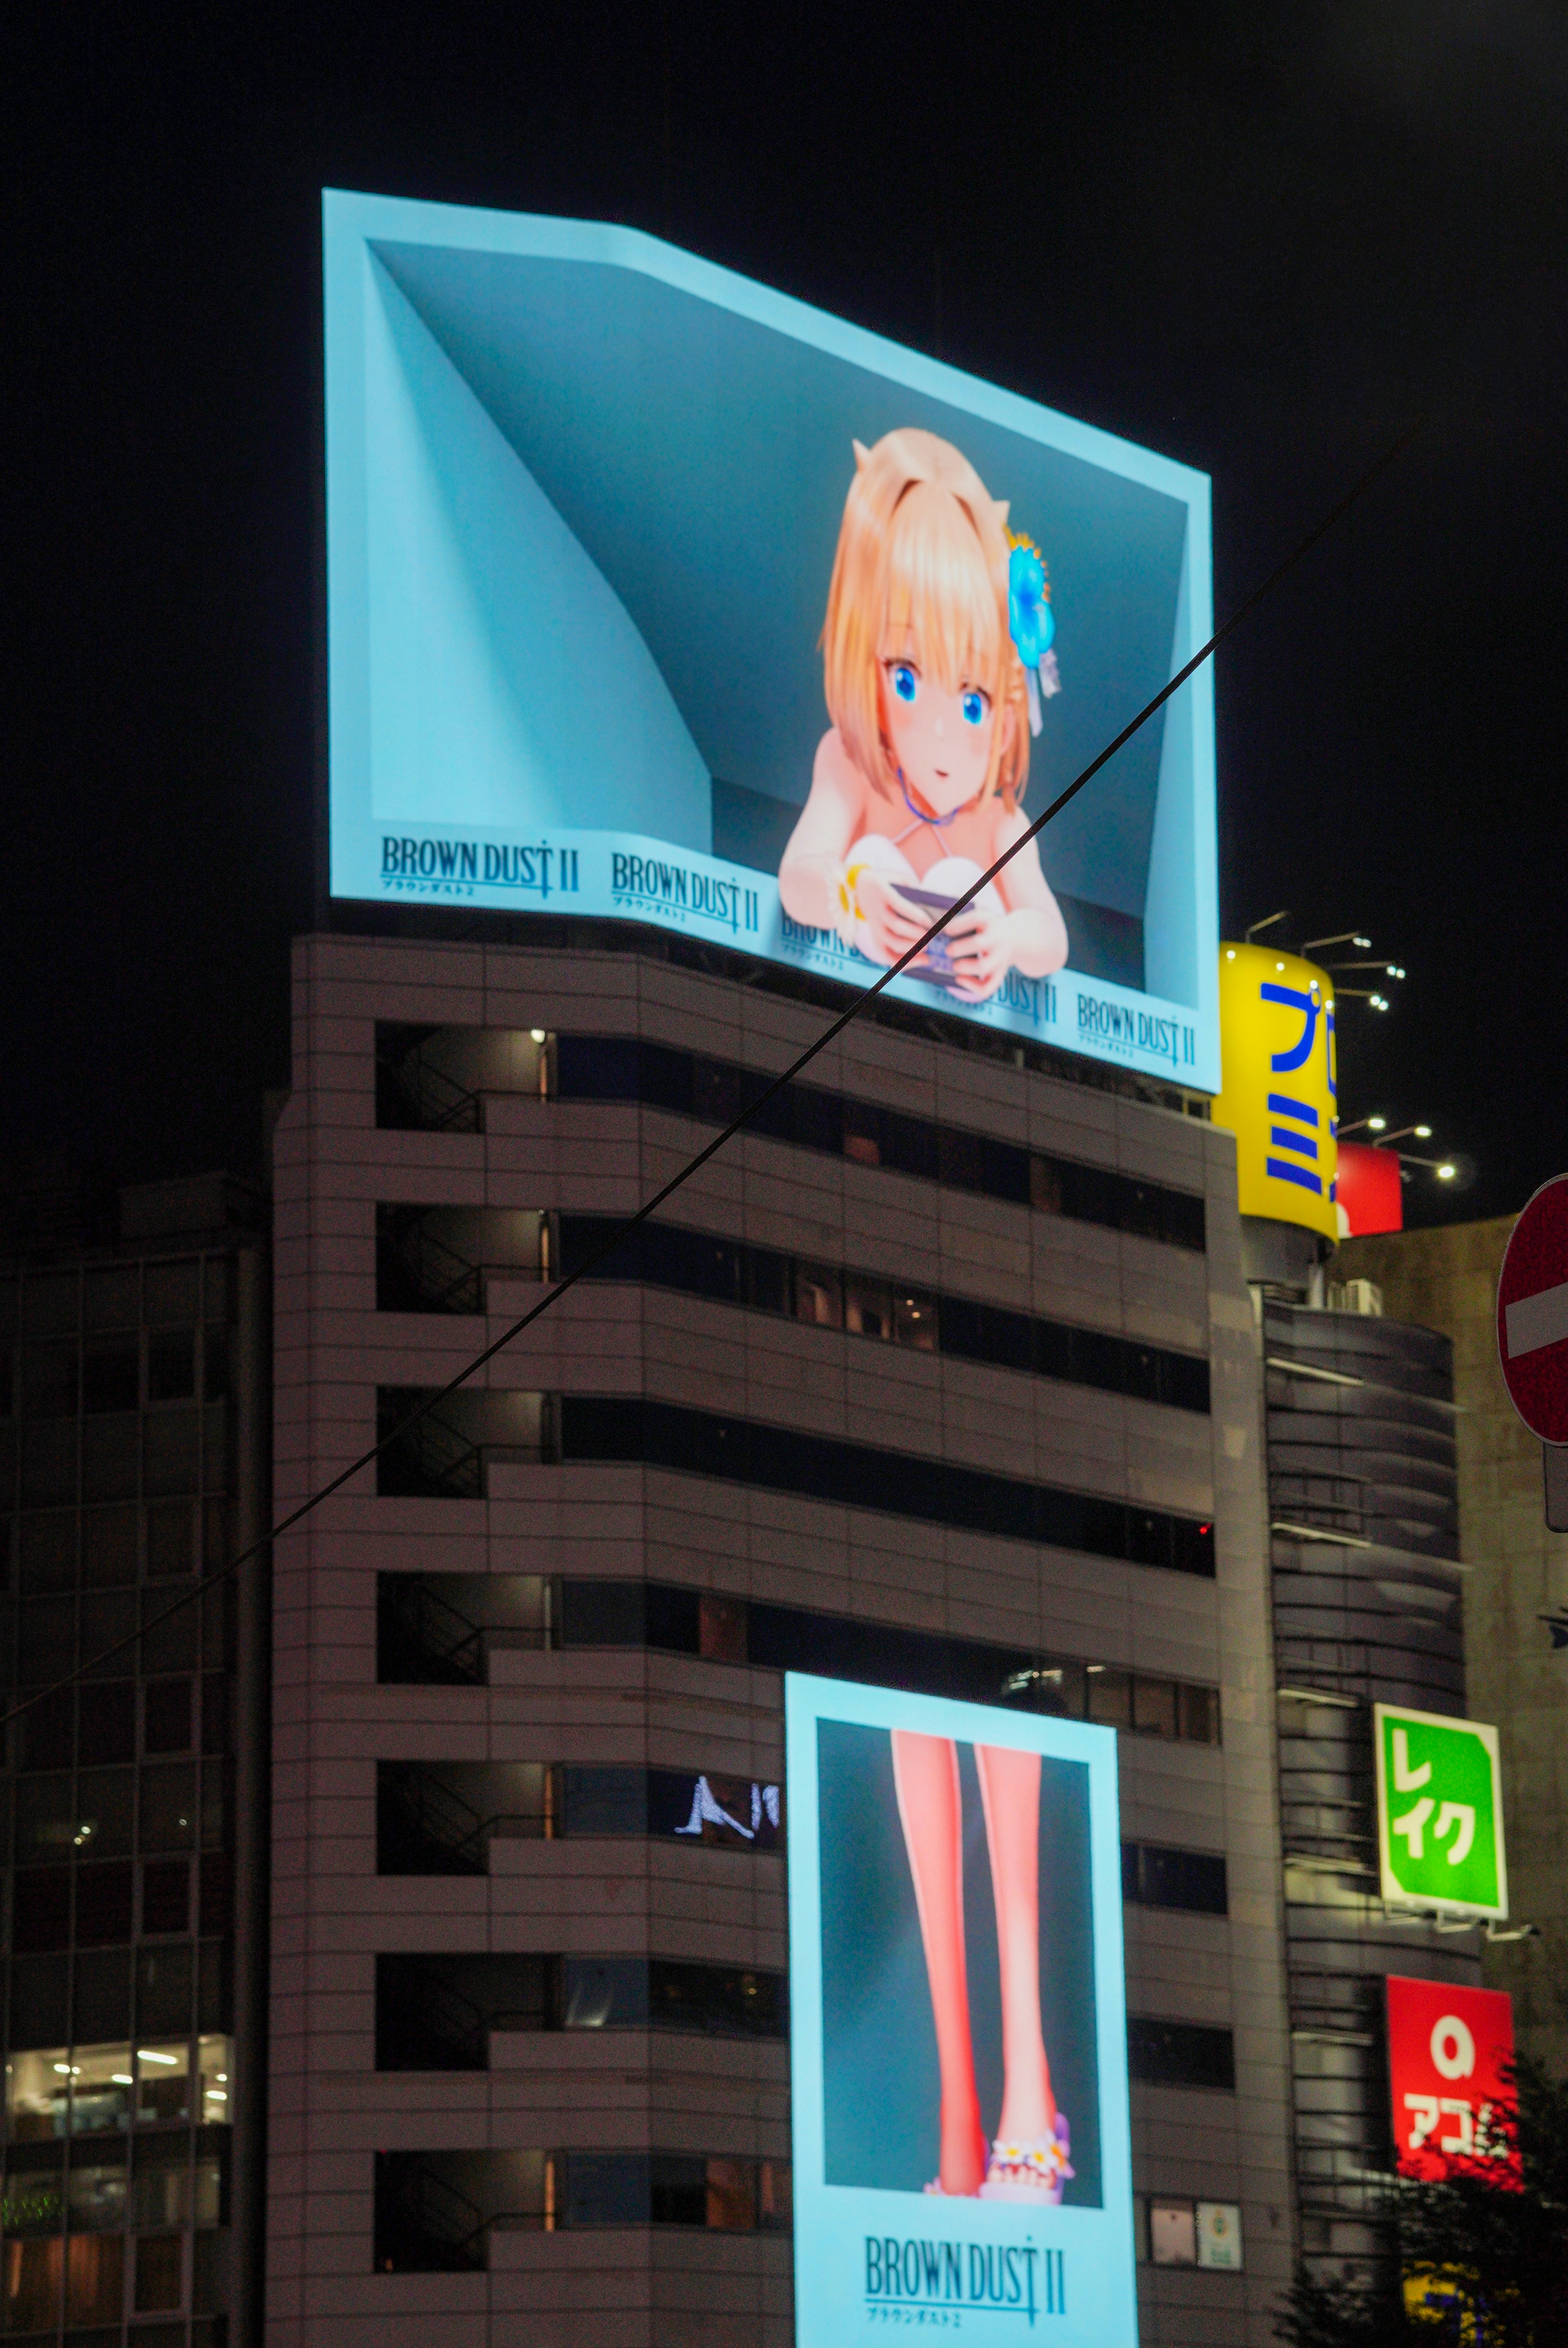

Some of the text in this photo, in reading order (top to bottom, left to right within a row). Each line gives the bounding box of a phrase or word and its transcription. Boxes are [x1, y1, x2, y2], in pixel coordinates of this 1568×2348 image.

[381, 836, 579, 899] BROWN DUST II
[612, 853, 758, 935] BROWN DUST II
[1077, 993, 1135, 1042] BROWN
[1138, 1011, 1178, 1068] DUST
[1183, 1026, 1195, 1066] II
[865, 2235, 1065, 2328] BROWN DUST II
